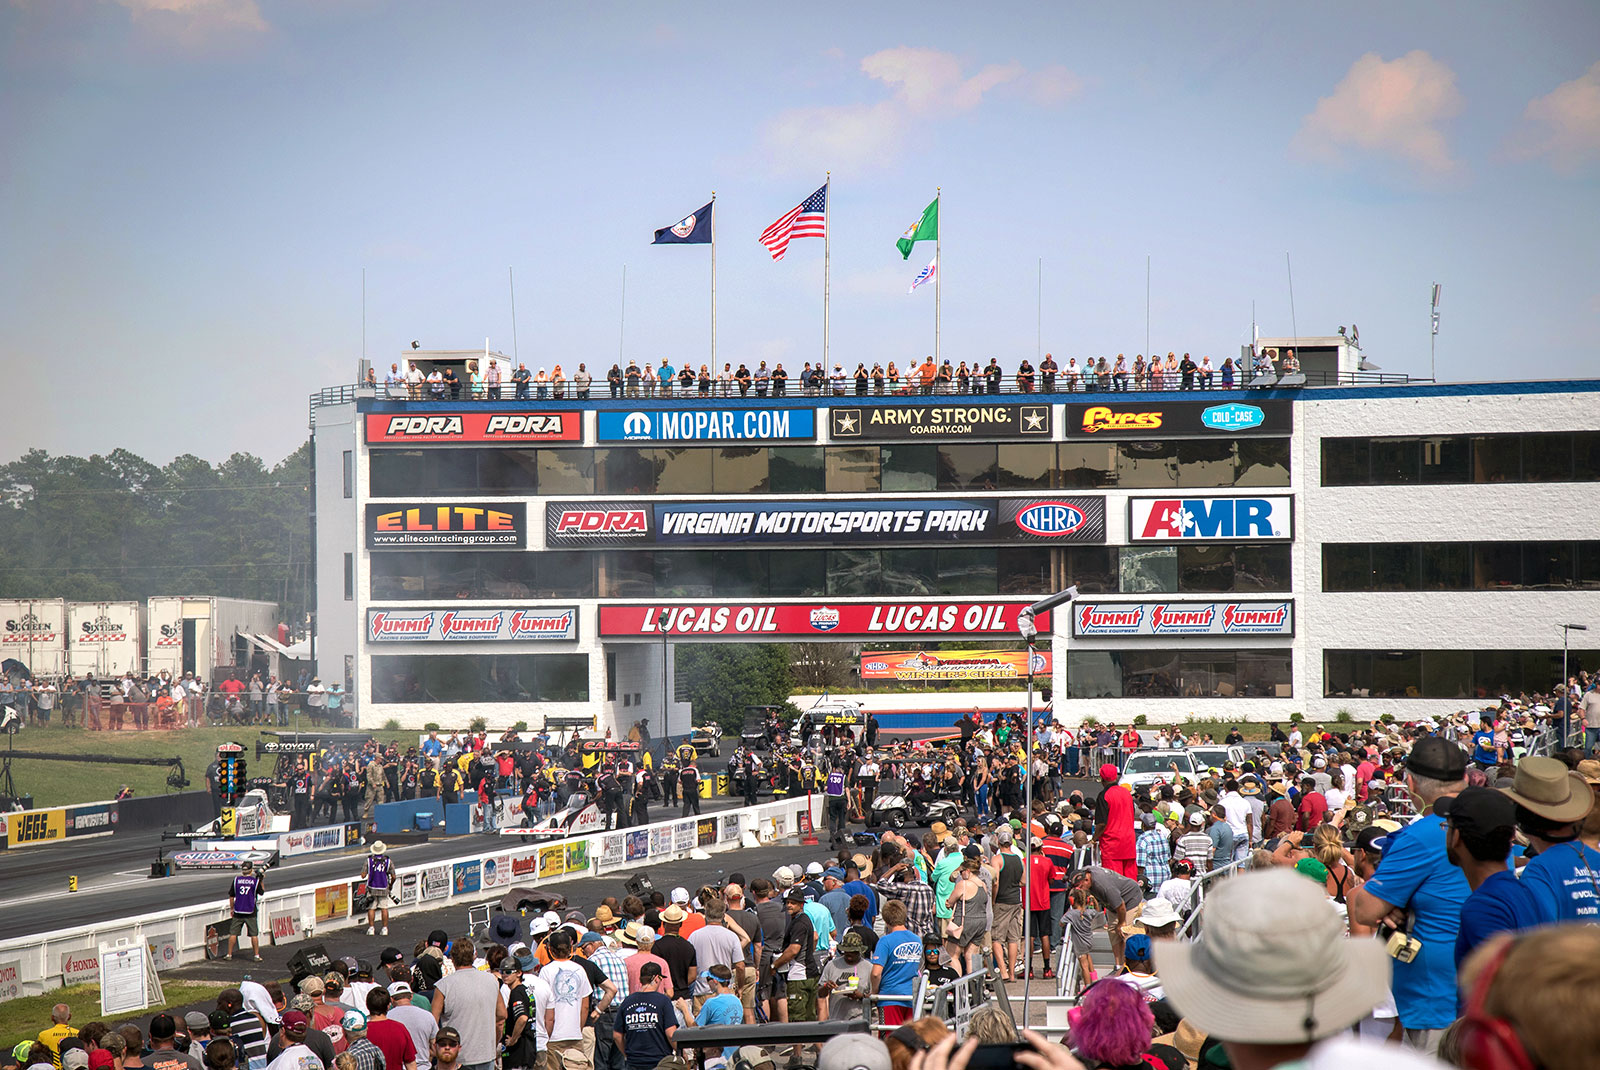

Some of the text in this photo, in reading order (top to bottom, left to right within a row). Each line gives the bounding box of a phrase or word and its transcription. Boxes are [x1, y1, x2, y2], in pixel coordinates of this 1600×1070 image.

[387, 416, 463, 434] PDRA
[486, 416, 563, 434] PDRA
[662, 410, 790, 439] MOPAR.COM
[870, 409, 925, 424] ARMY
[910, 425, 972, 434] GOARMY.COM
[376, 506, 514, 530] ELITE
[556, 510, 648, 533] PDRA
[662, 510, 990, 534] VIRGINIA MOTORSPORTS PARK
[1026, 508, 1078, 530] NHRA
[1141, 499, 1274, 537] AMR
[374, 534, 517, 544] www.elitecontractinggroup.com
[641, 606, 778, 632] LUCAS OIL
[867, 606, 1007, 631] LUCAS OIL
[896, 670, 967, 679] WINNER'S
[969, 670, 1018, 678] CIRCLE
[580, 811, 597, 824] CAPCO
[240, 886, 250, 895] 37
[272, 916, 296, 939] LUCAS OIL
[73, 958, 99, 972] HONDA
[625, 1013, 658, 1024] COSTA
